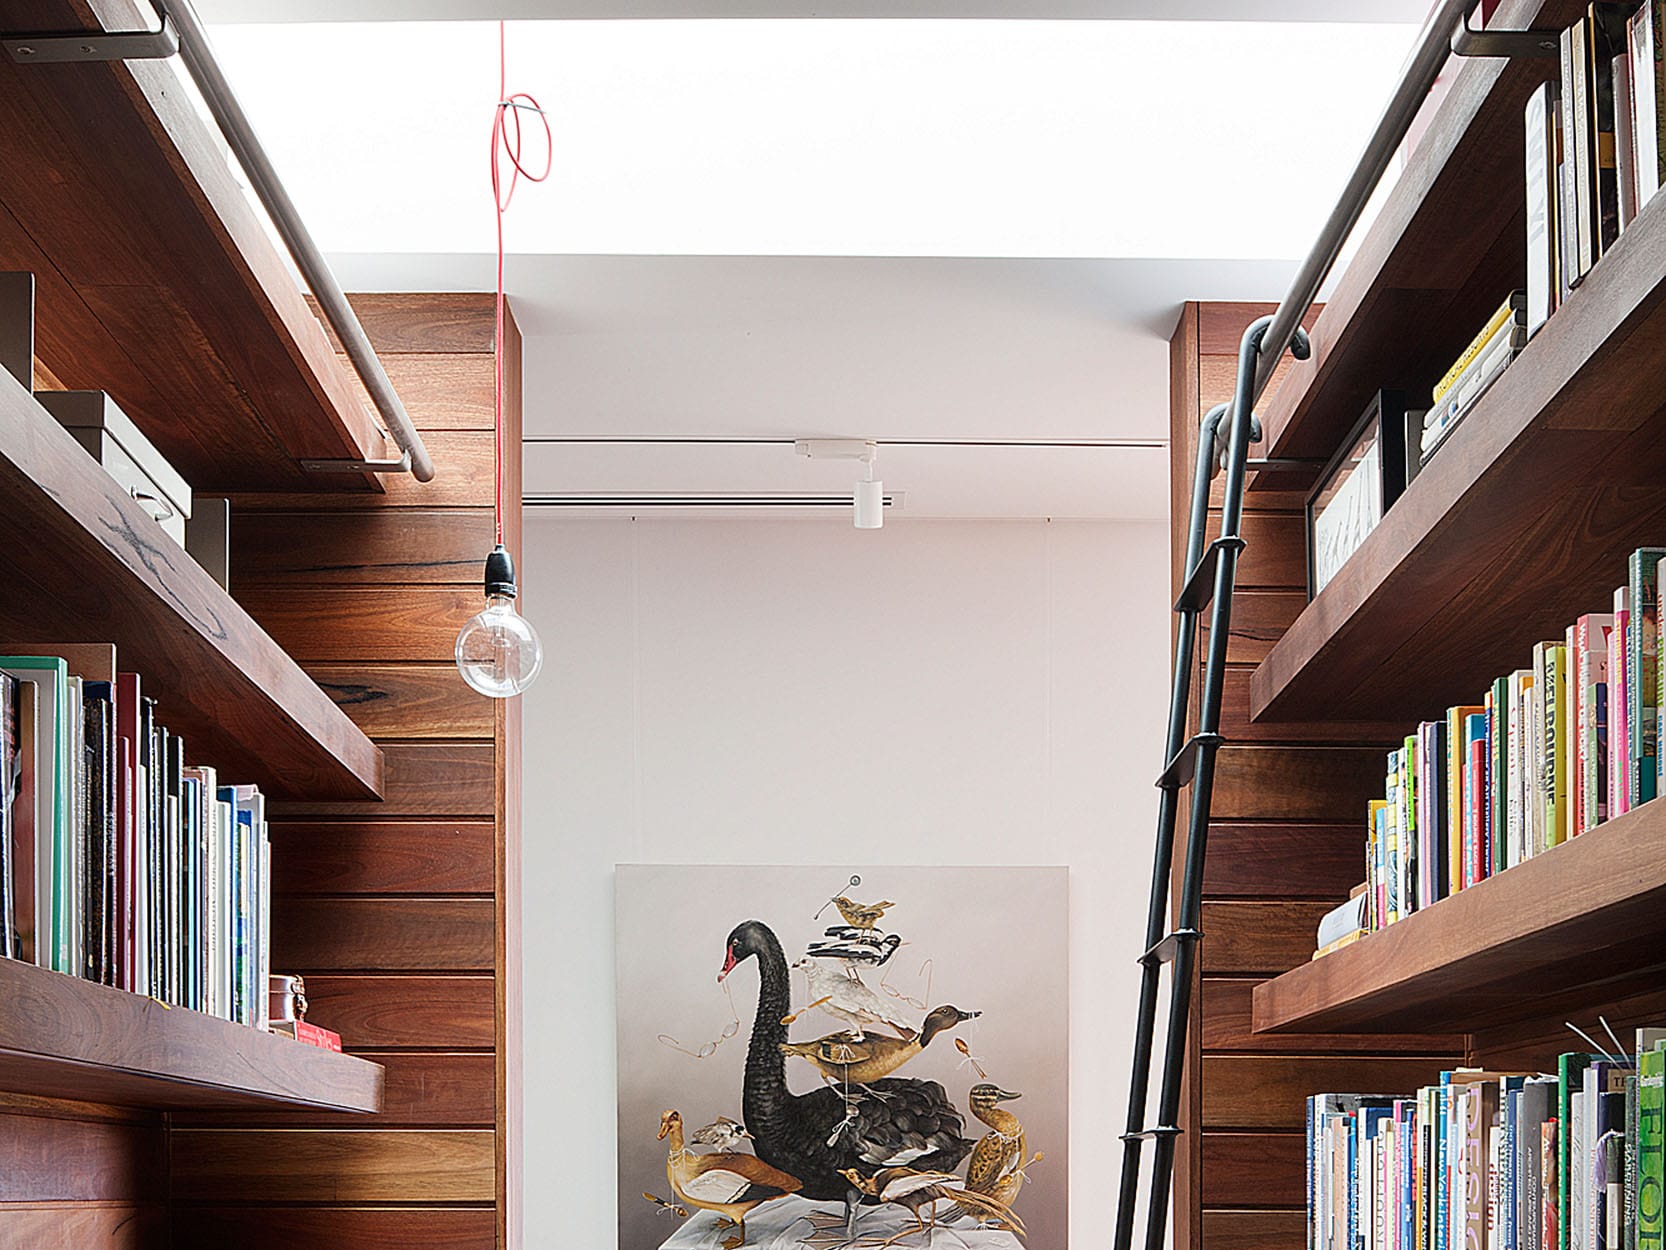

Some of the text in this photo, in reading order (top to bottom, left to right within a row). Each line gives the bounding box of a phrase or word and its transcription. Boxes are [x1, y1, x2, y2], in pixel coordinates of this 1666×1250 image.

[1545, 662, 1556, 806] MELBOURNE
[1438, 1138, 1447, 1166] New
[1623, 1143, 1633, 1226] GARDENING
[1438, 1171, 1447, 1208] York
[1487, 1163, 1500, 1231] design
